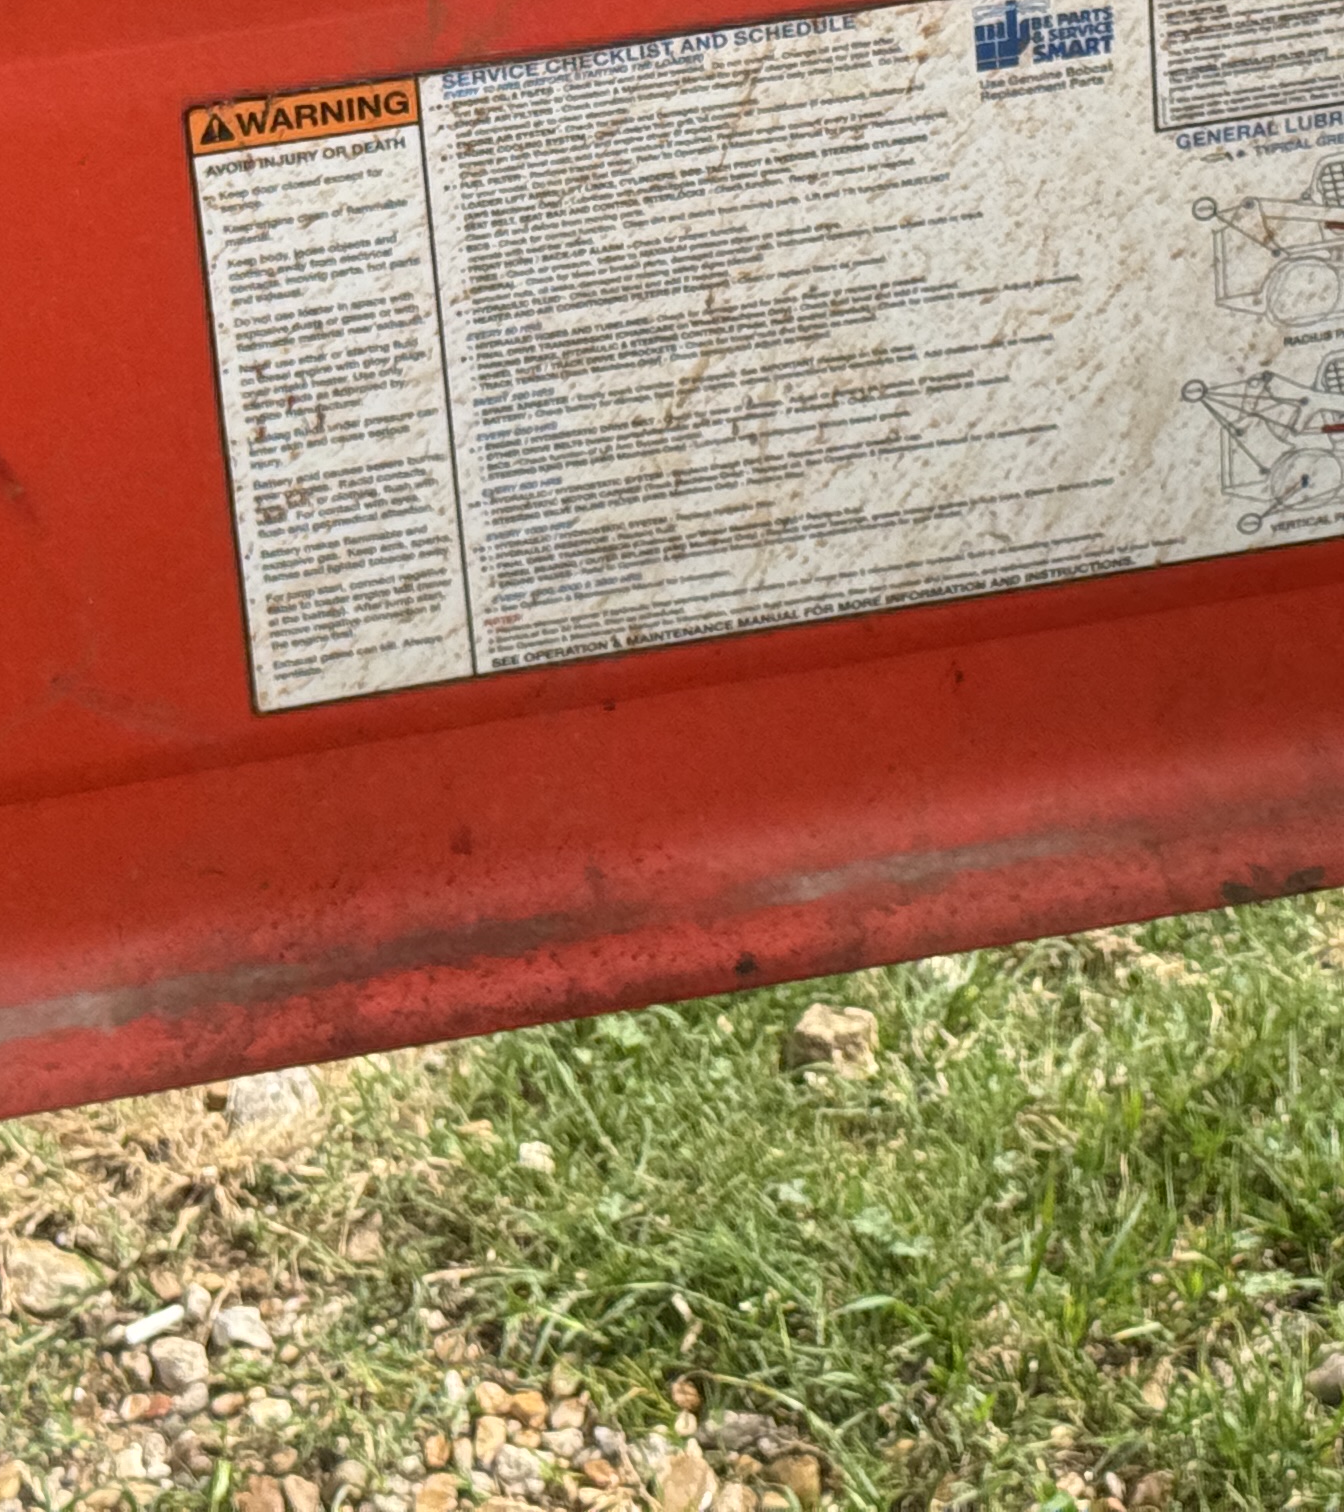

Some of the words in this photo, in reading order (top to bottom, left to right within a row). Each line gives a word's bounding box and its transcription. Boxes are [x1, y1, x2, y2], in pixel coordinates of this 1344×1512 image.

[1031, 14, 1053, 30] BE
[1057, 6, 1112, 26] PARTS
[1032, 30, 1044, 43] &
[1048, 20, 1112, 41] SERVICE
[442, 61, 538, 89] SERVICE
[544, 40, 674, 74] CHECKLIST
[680, 32, 727, 54] AND
[733, 14, 856, 46] SCHEDULE
[1032, 35, 1113, 64] SMART
[979, 76, 1005, 90] Use
[1008, 68, 1062, 86] Genuine
[1066, 60, 1113, 78] Bobcat
[980, 80, 1066, 102] Replacement
[1069, 74, 1104, 89] Parts
[235, 89, 410, 138] WARNING
[1176, 119, 1280, 150] GENERAL
[1255, 137, 1311, 156] TYPICAL
[205, 158, 256, 177] AVOID
[259, 149, 317, 169] INJURY
[322, 145, 347, 160] OR
[351, 136, 406, 156] DEATH
[1283, 328, 1333, 348] RADIUS
[1271, 513, 1331, 534] VERTICAL
[491, 654, 519, 668] SEE
[524, 639, 608, 663] OPERATION
[626, 620, 733, 646] MAINTENANCE
[737, 609, 798, 628] MANUAL
[803, 602, 834, 617] FOR
[837, 596, 880, 612] MORE
[885, 579, 986, 605] INFORMATION
[990, 573, 1020, 588] AND
[1025, 555, 1135, 583] INSTRUCTIONS.
